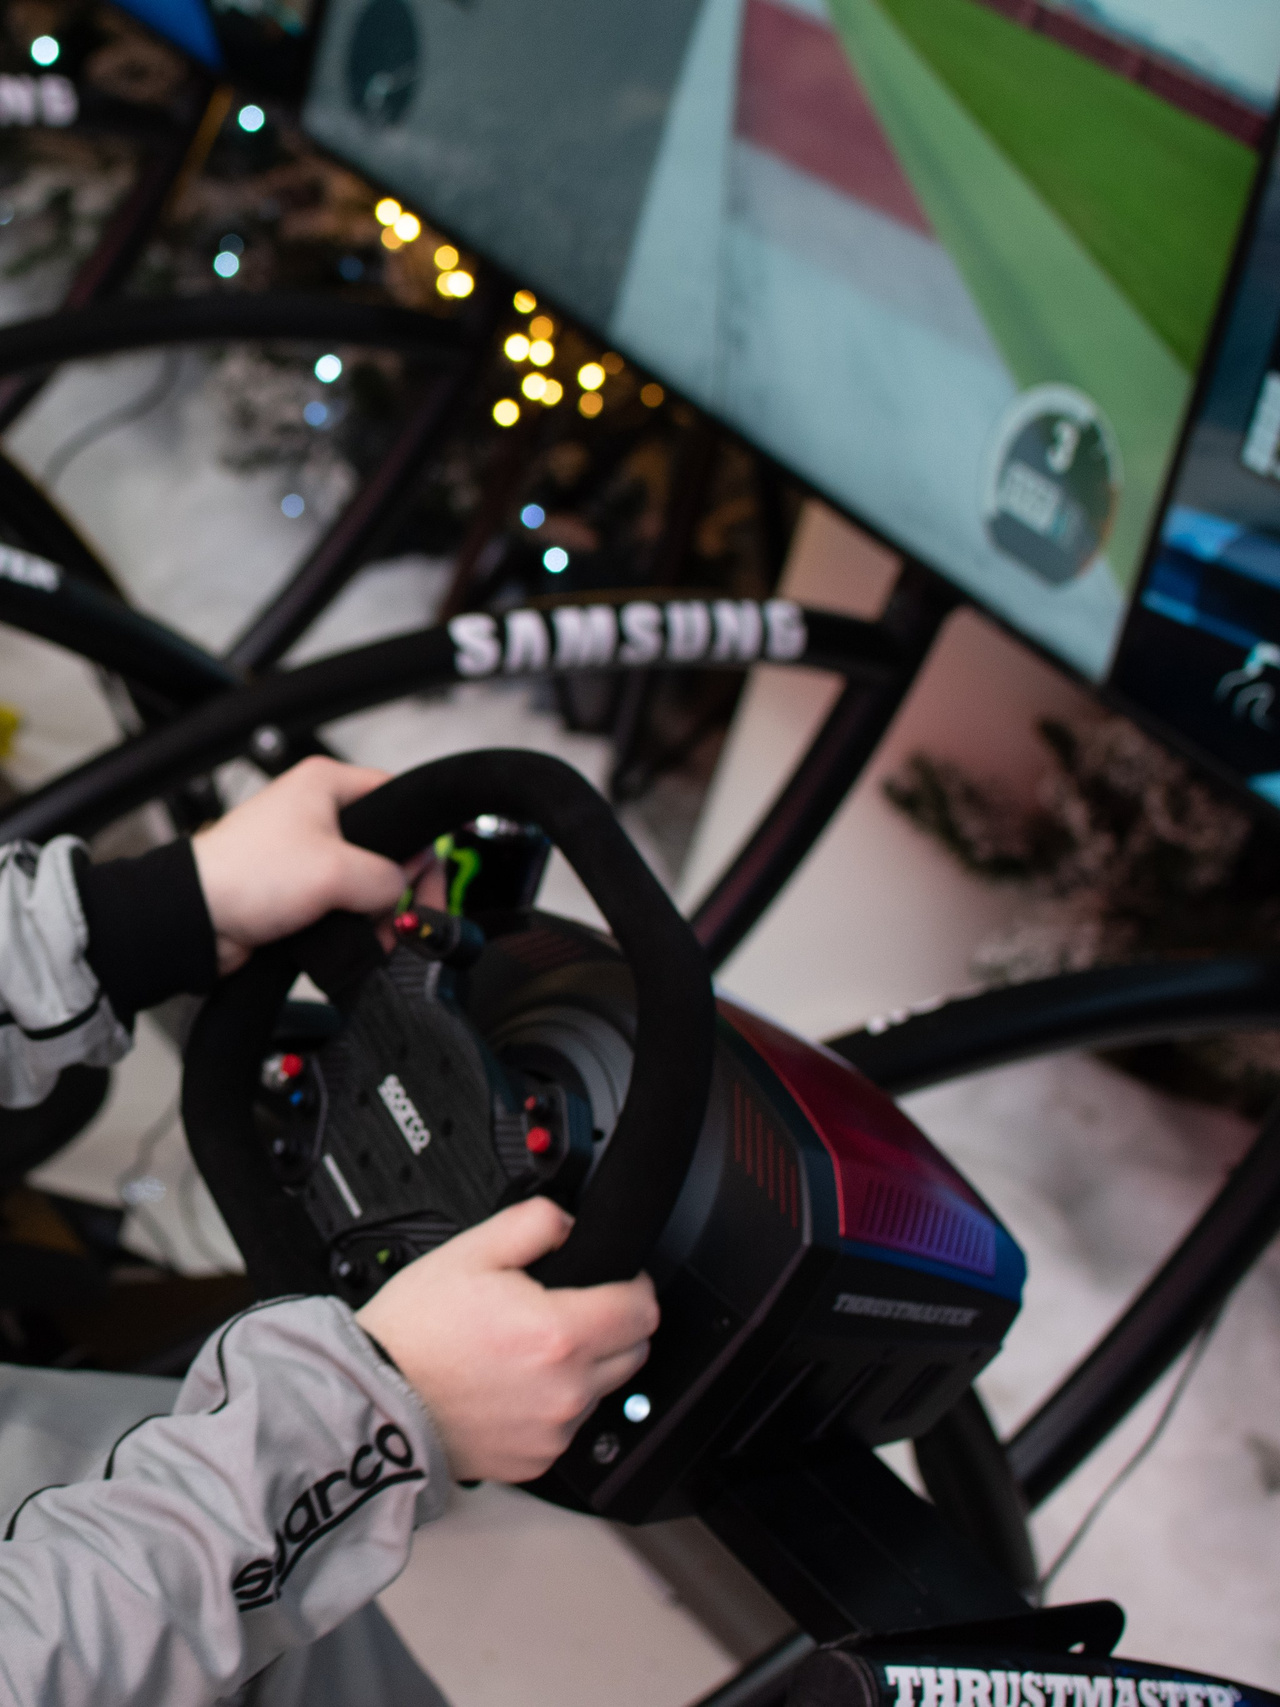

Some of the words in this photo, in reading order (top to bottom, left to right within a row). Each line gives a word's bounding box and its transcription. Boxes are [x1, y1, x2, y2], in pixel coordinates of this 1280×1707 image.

[448, 599, 808, 677] SAMSUNG
[377, 1074, 431, 1155] sparco
[832, 1293, 978, 1327] THRUSTMASTER
